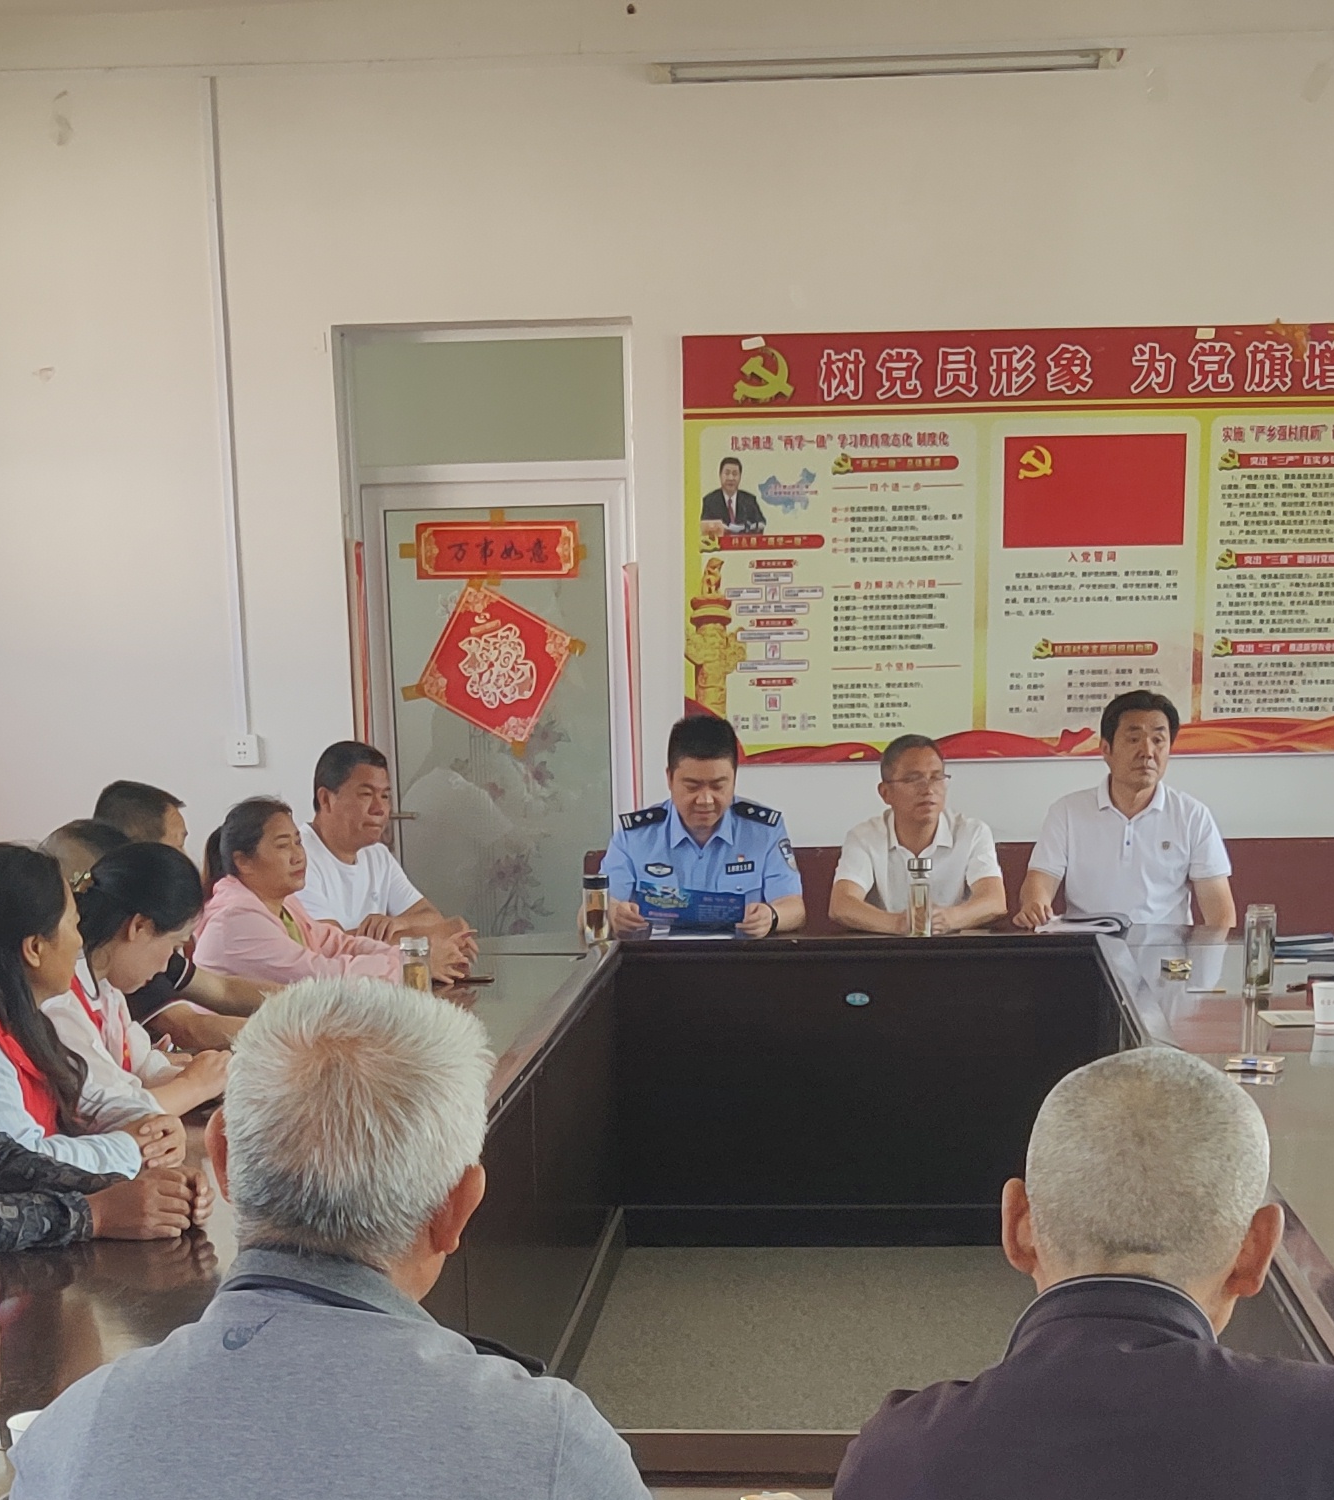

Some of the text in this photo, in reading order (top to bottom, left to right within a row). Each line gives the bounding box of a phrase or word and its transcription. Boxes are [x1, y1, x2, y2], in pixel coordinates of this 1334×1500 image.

[818, 344, 1095, 400] 树党员形象
[447, 537, 549, 565] 万事如意
[1067, 551, 1117, 563] 入党誓词
